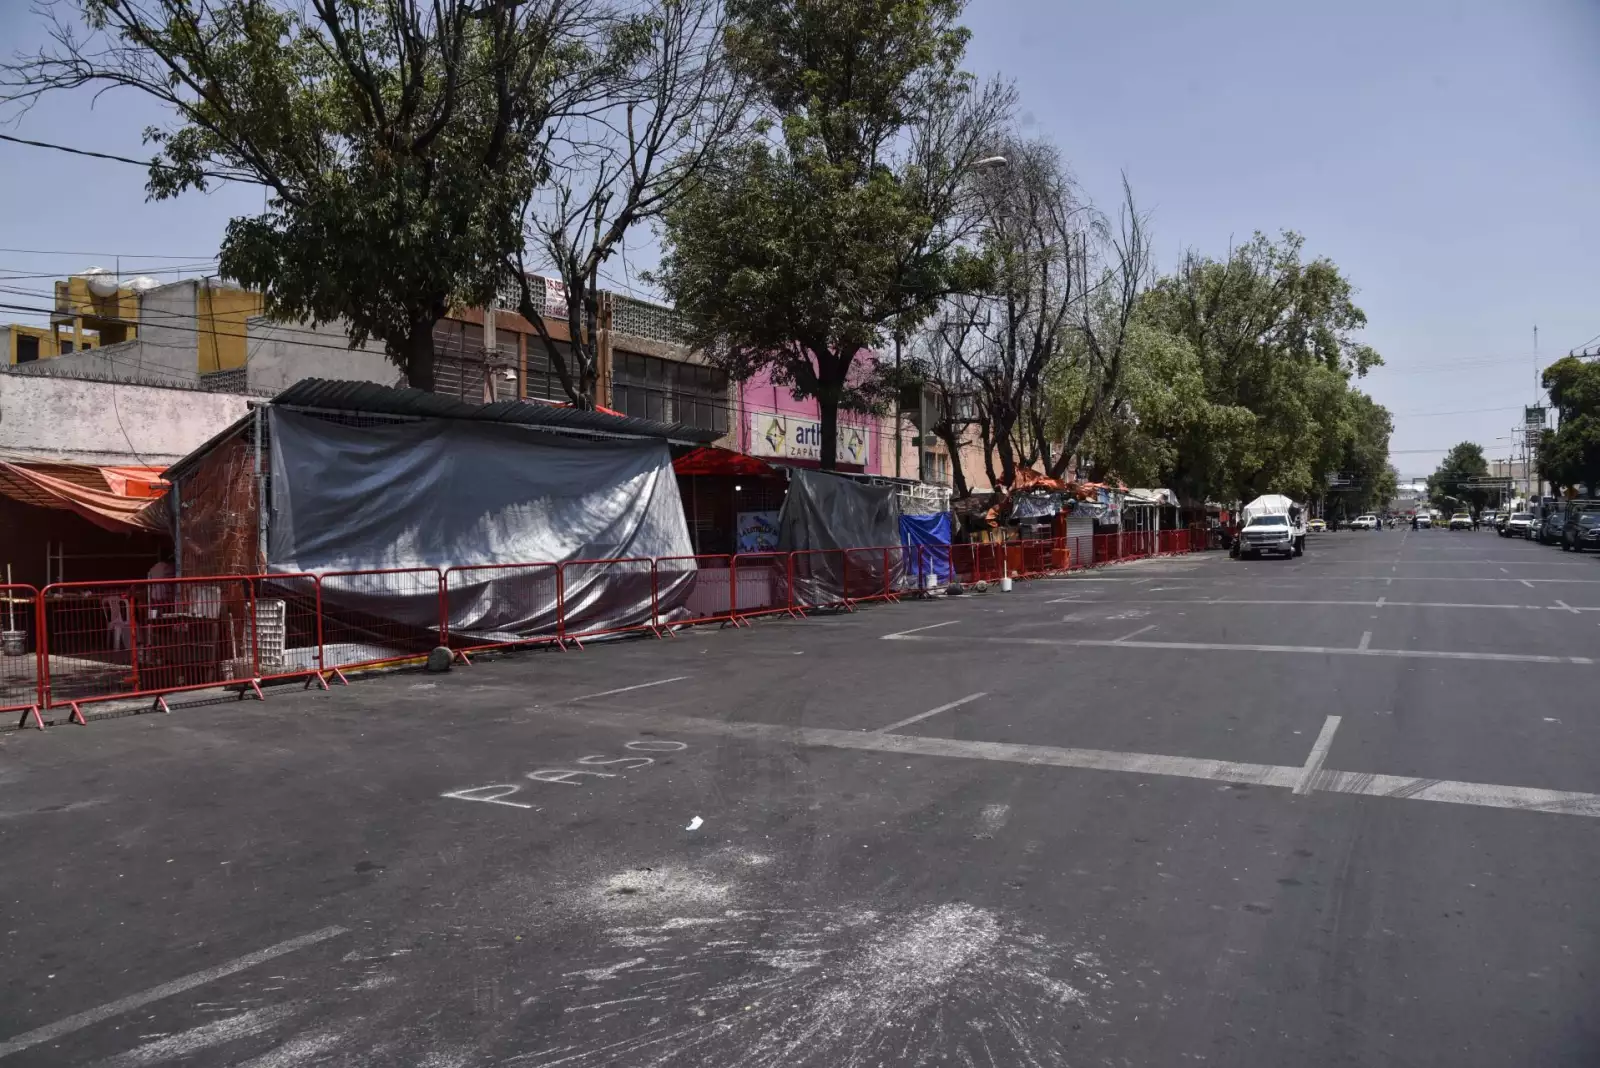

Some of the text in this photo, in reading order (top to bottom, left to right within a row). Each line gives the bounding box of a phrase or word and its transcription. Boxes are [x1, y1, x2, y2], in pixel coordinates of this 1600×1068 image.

[796, 423, 837, 447] arth
[791, 447, 844, 460] ZAPATS
[440, 740, 688, 809] PASO
